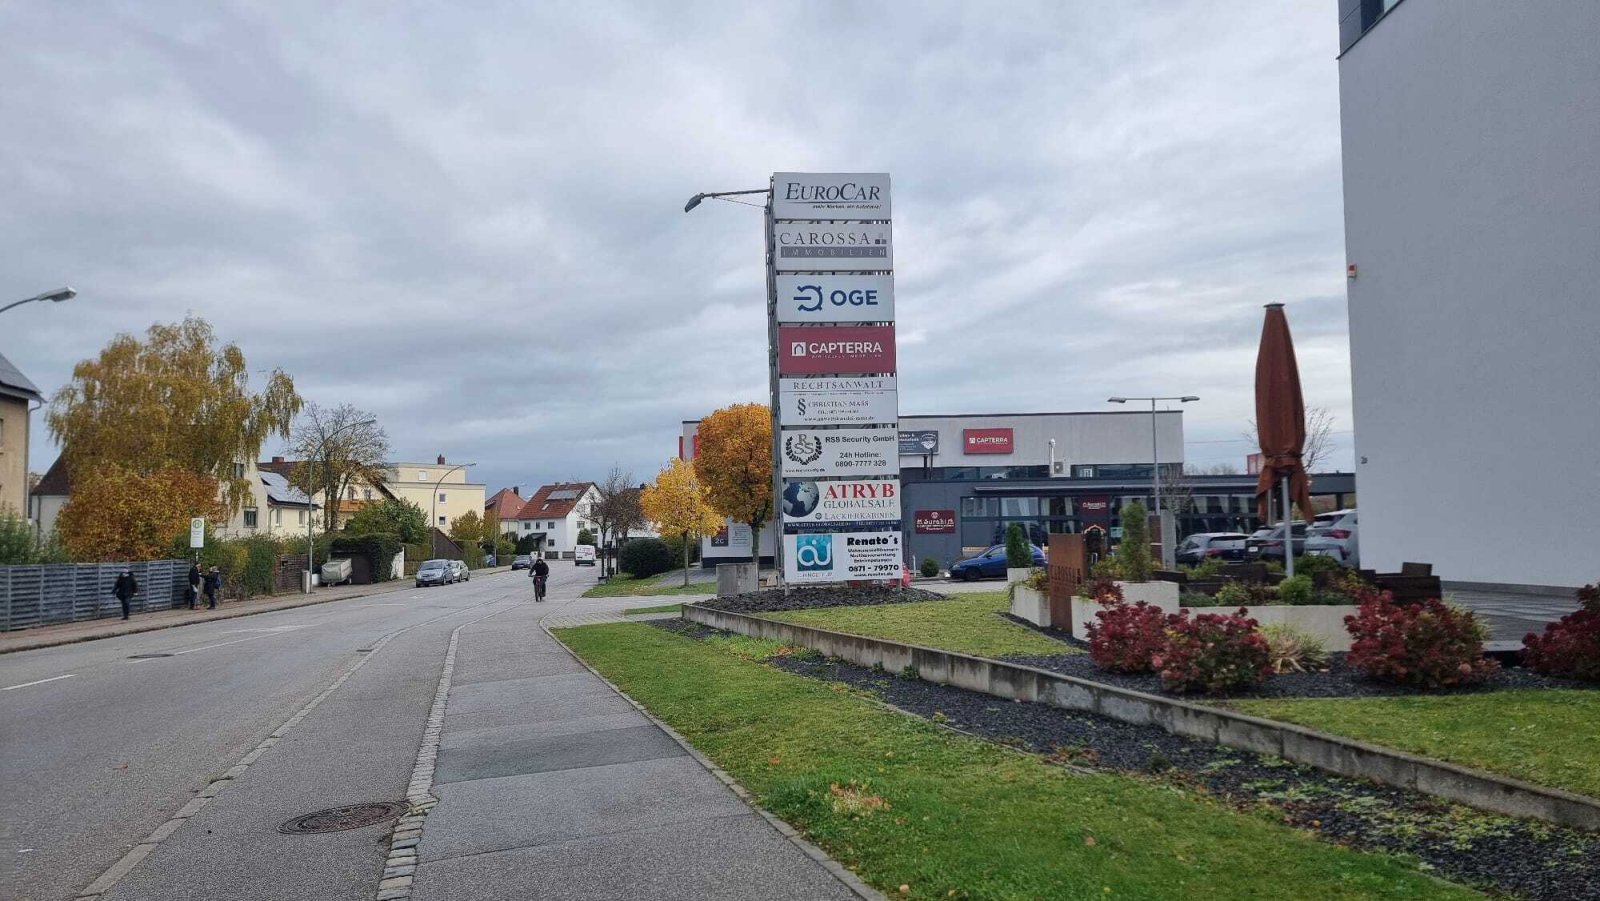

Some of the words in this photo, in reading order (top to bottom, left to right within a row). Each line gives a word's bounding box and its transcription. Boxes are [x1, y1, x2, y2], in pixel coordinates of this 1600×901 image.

[780, 232, 870, 245] CAROSSA
[830, 290, 878, 306] OGE
[809, 342, 882, 354] CAPTERRA
[793, 380, 884, 390] RECHTSANWALT
[808, 400, 847, 408] CHRISTIAN
[841, 436, 871, 444] Security
[824, 483, 895, 499] ATRYB
[823, 500, 896, 509] GLOBALSALE
